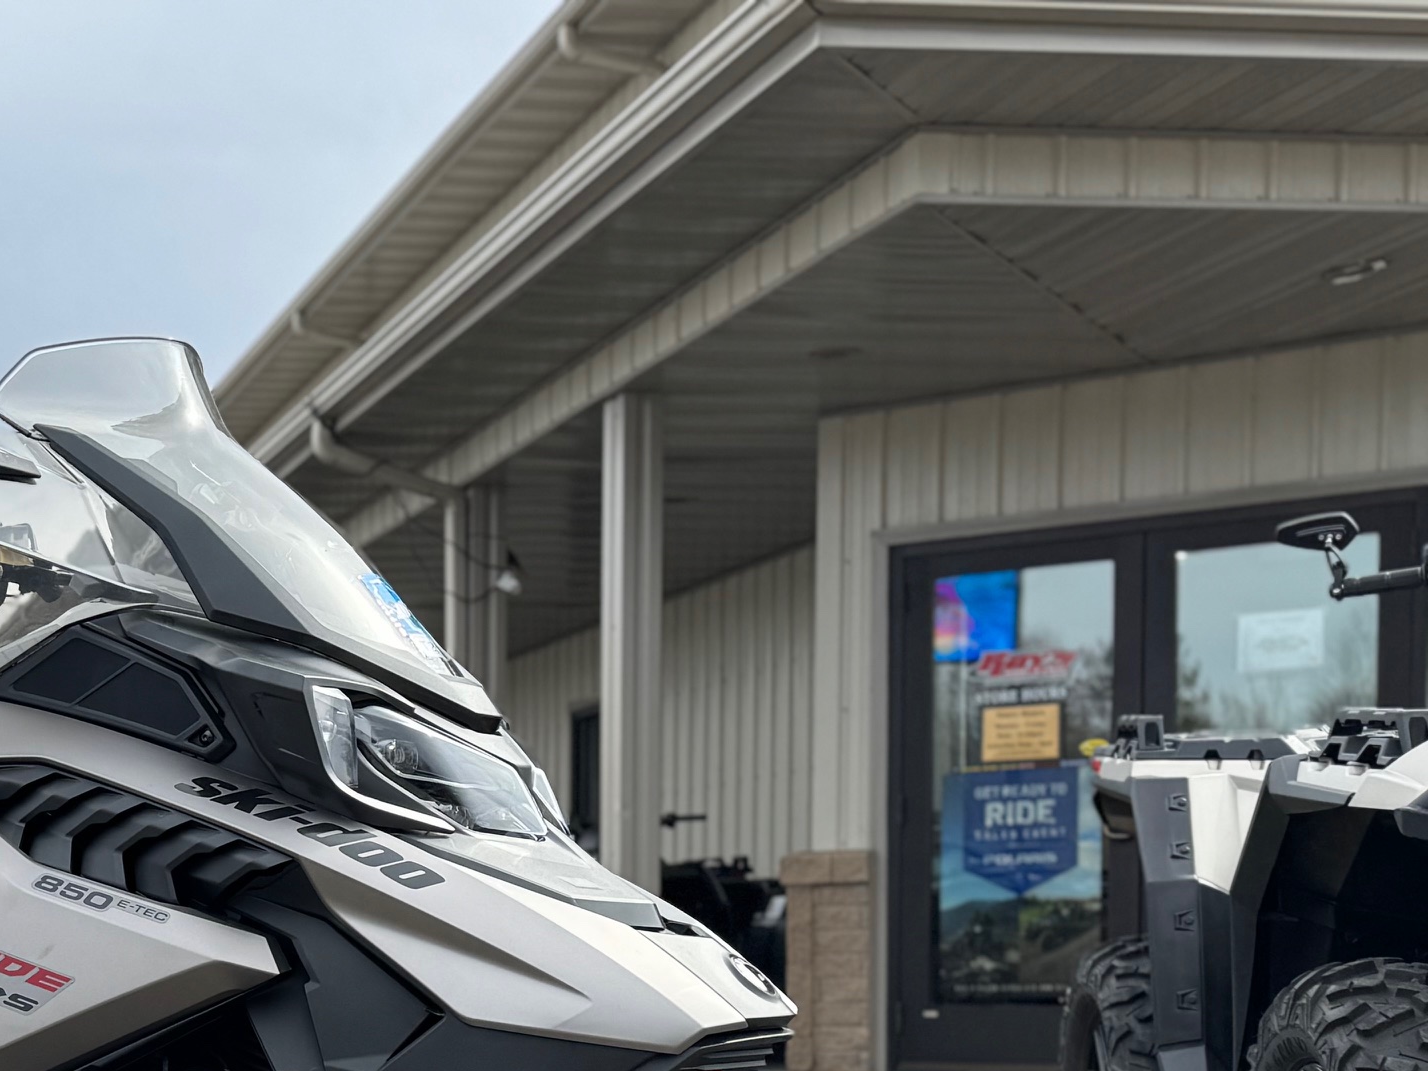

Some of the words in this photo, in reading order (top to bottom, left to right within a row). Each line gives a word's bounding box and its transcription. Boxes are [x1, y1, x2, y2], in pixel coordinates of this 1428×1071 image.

[985, 798, 1057, 829] RIDE
[34, 875, 113, 910] 850
[117, 900, 168, 922] E-TEC
